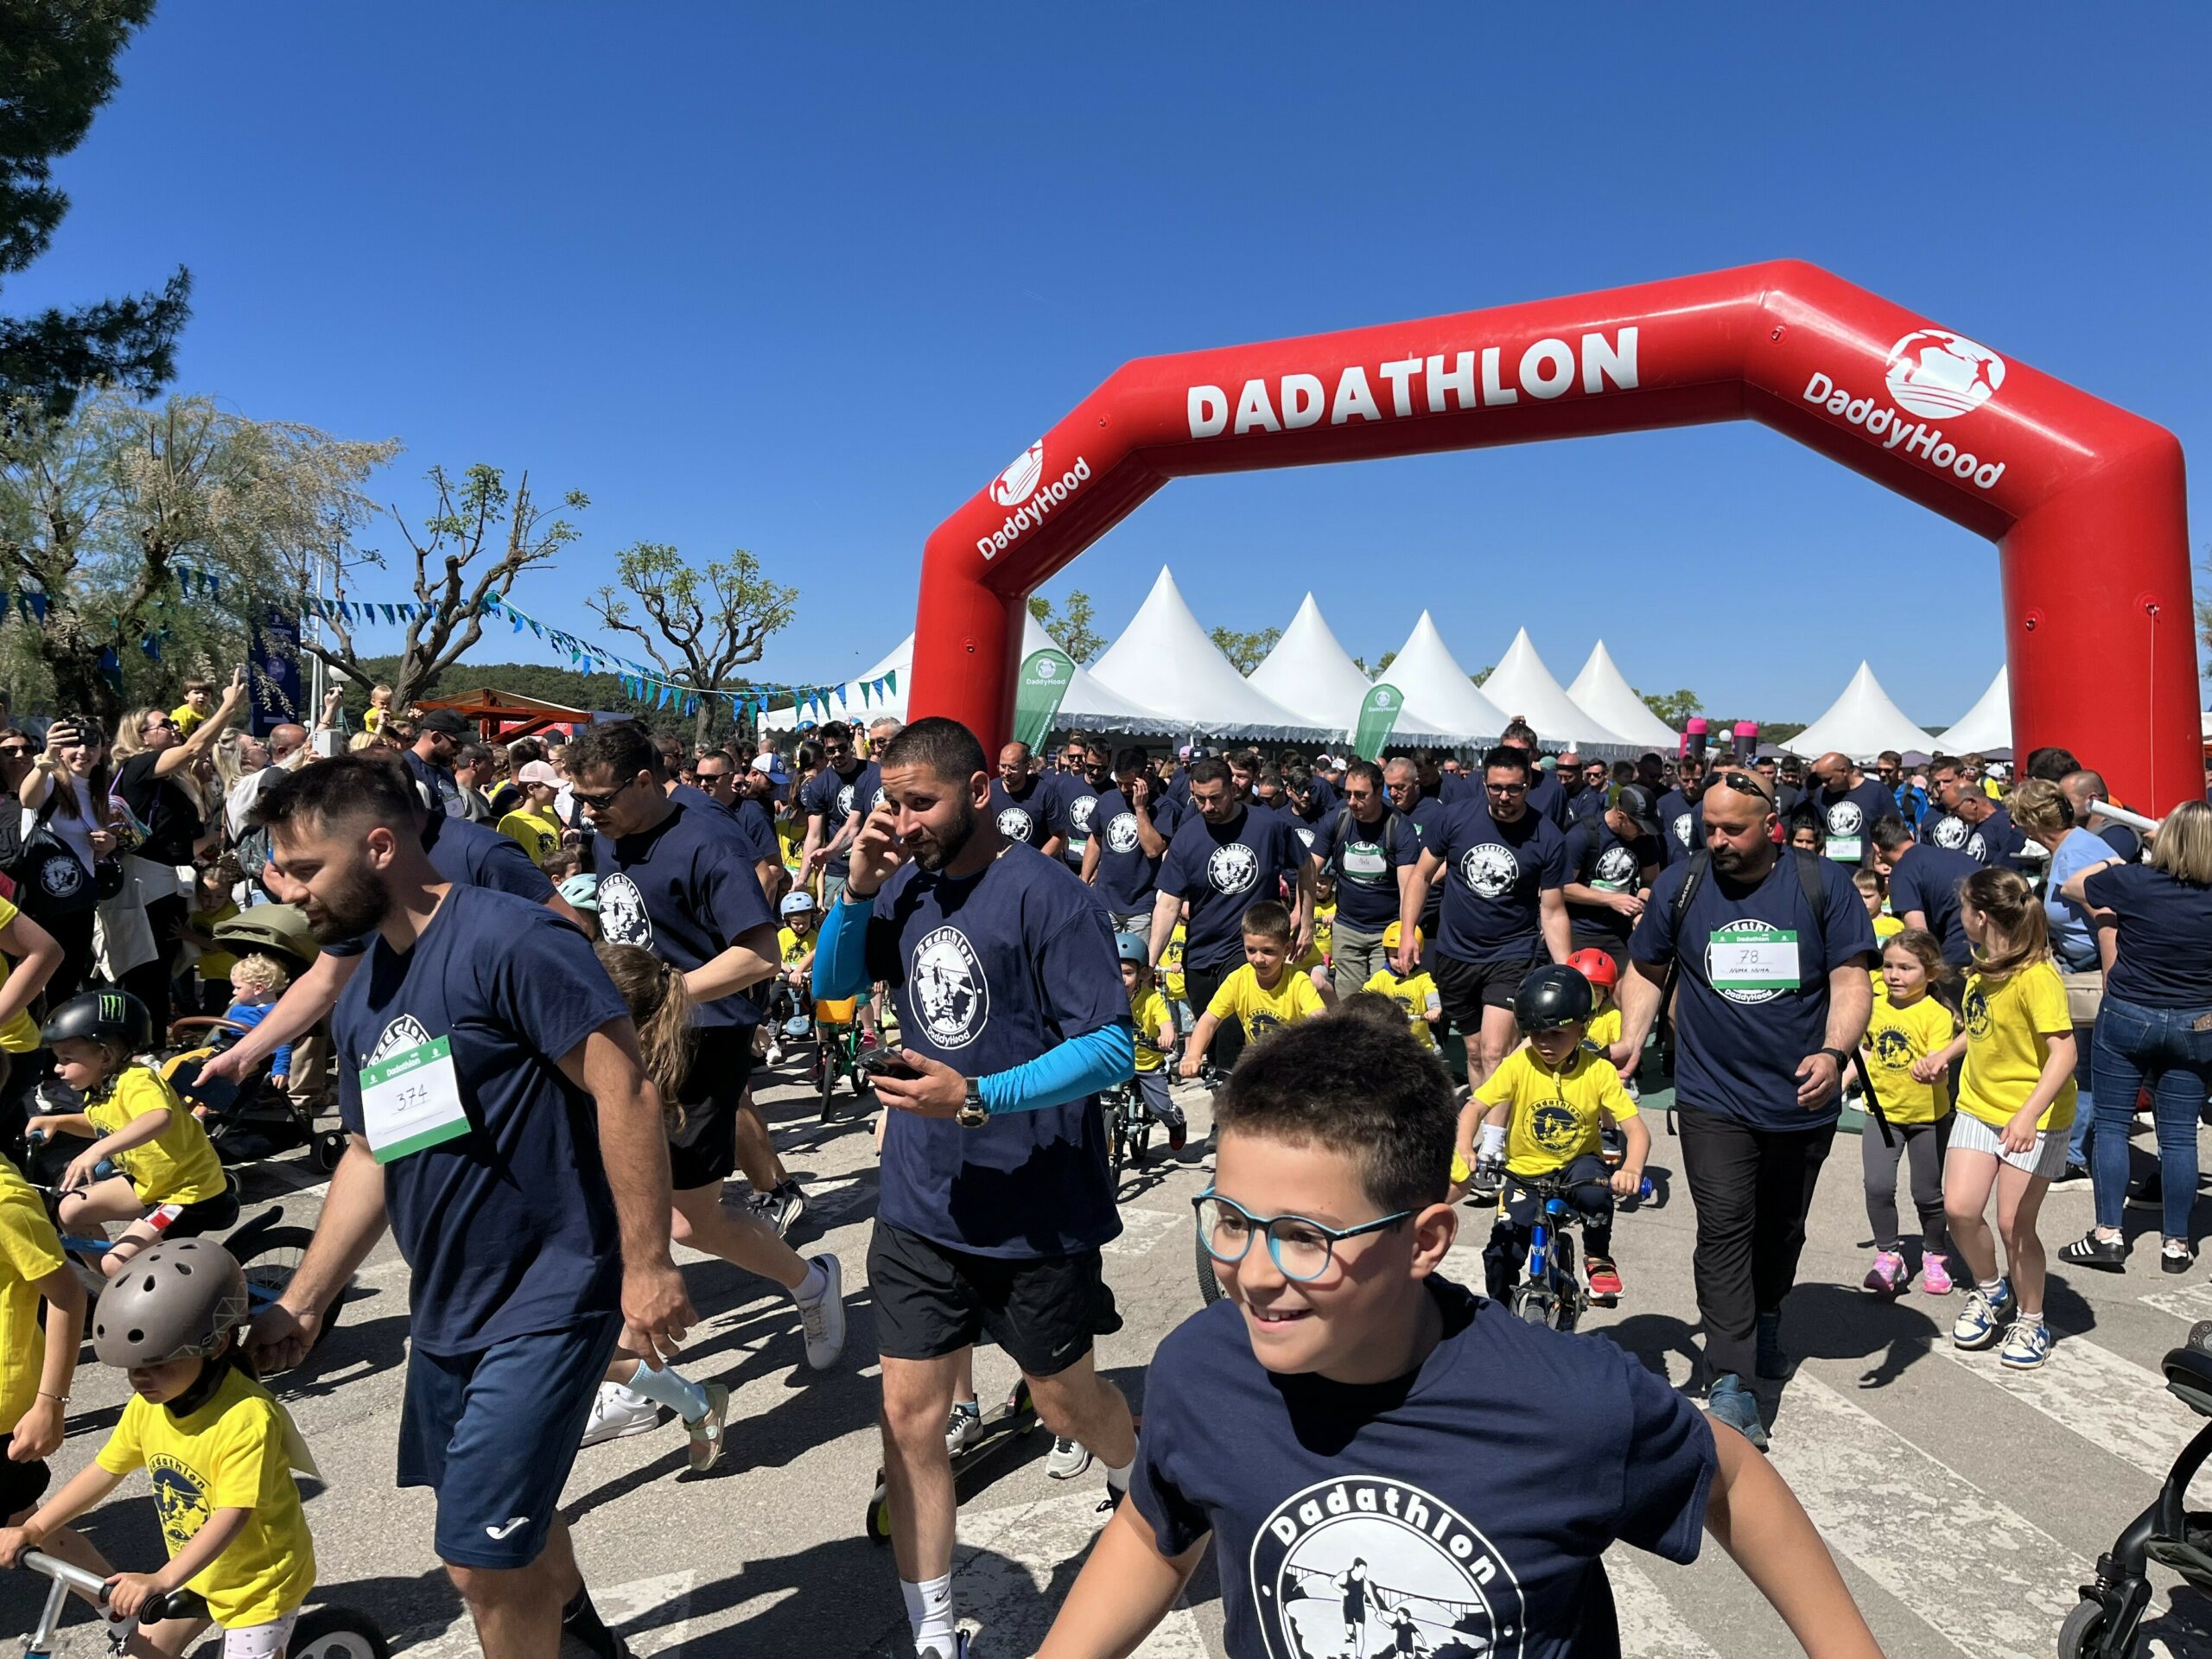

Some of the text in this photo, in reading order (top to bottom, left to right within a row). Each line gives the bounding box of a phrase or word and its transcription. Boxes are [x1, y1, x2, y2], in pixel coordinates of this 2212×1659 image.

[1187, 327, 1638, 438] DADATHLON
[1802, 372, 2005, 489] DaddyHood
[976, 456, 1090, 561] DaddyHood
[918, 930, 974, 966] Dadathlon
[1739, 950, 1759, 963] 78
[1724, 988, 1773, 1002] DaddyHood
[927, 1025, 971, 1046] DaddyHood
[386, 1058, 421, 1077] Dadathlon
[396, 1084, 429, 1111] 374
[1530, 1099, 1581, 1118] Dadathlon
[1270, 1484, 1497, 1585] Dadathlon
